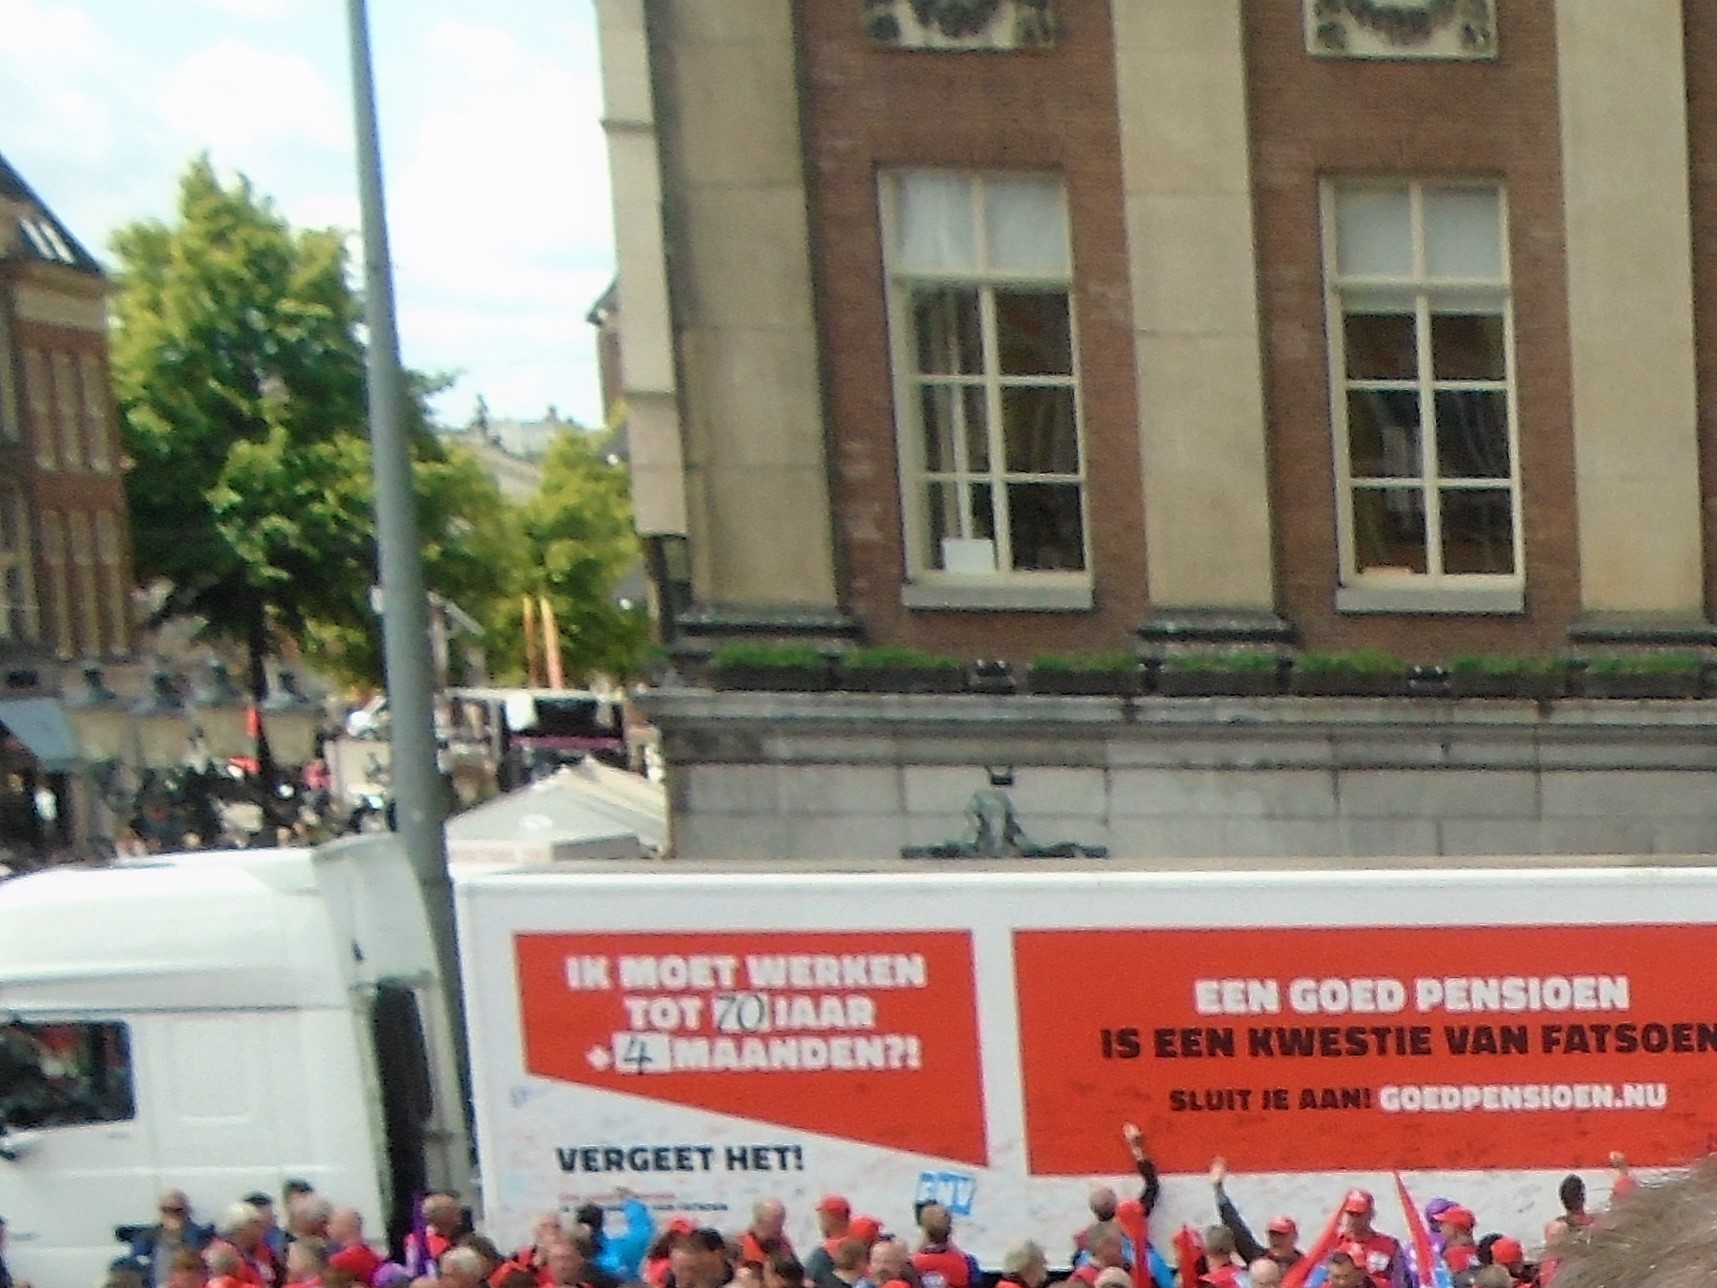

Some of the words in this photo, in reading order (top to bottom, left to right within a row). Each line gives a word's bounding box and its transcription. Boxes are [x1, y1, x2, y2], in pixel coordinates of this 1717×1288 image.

[566, 955, 609, 990] IK
[618, 954, 738, 990] MOET
[747, 952, 926, 989] WERKEN
[625, 997, 700, 1031] TOT
[717, 994, 766, 1031] 70
[1194, 977, 1282, 1015] EEN
[1289, 977, 1408, 1015] GOED
[1413, 976, 1631, 1013] PENSIOEN
[674, 1034, 921, 1070] MAANDEN?!
[1100, 1027, 1141, 1059] IS
[1154, 1027, 1235, 1058] EEN
[1248, 1026, 1432, 1058] KWESTIE
[1444, 1025, 1529, 1056] VAN
[1169, 1087, 1252, 1111] SLUIT
[1299, 1087, 1371, 1110] AAN!
[1379, 1083, 1667, 1112] GOEDPENSIOEN.NU
[555, 1145, 715, 1173] VERGEET
[726, 1144, 805, 1172] HET!
